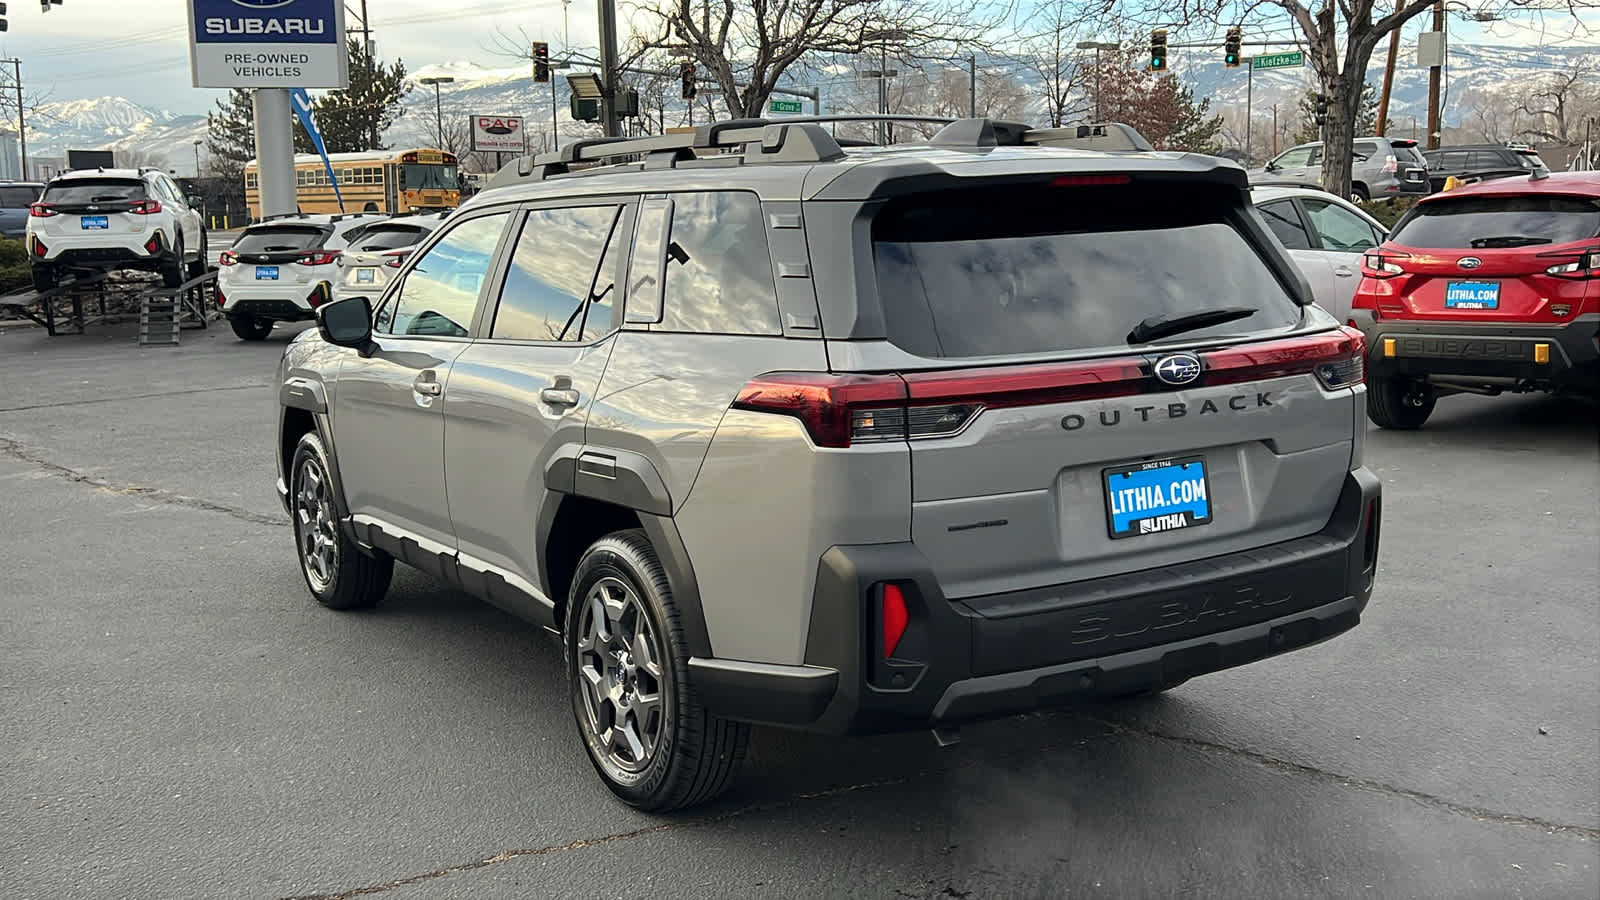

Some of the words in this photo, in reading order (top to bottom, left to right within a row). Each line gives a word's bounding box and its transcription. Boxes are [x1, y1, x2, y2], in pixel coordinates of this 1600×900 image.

[205, 17, 324, 34] SUBARU
[224, 54, 309, 64] PRE-OWNED
[1260, 56, 1290, 67] Kietzke
[233, 67, 302, 77] VEHICLES
[478, 117, 519, 128] CAC
[1447, 289, 1498, 301] LITHIA.COM
[1403, 337, 1526, 361] SUBARU
[1060, 391, 1273, 431] OUTBACK
[1142, 462, 1158, 470] SINCE
[1110, 477, 1207, 515] LITHIA.COM
[1151, 512, 1188, 533] LITHIA
[1071, 586, 1293, 645] SUBARU
